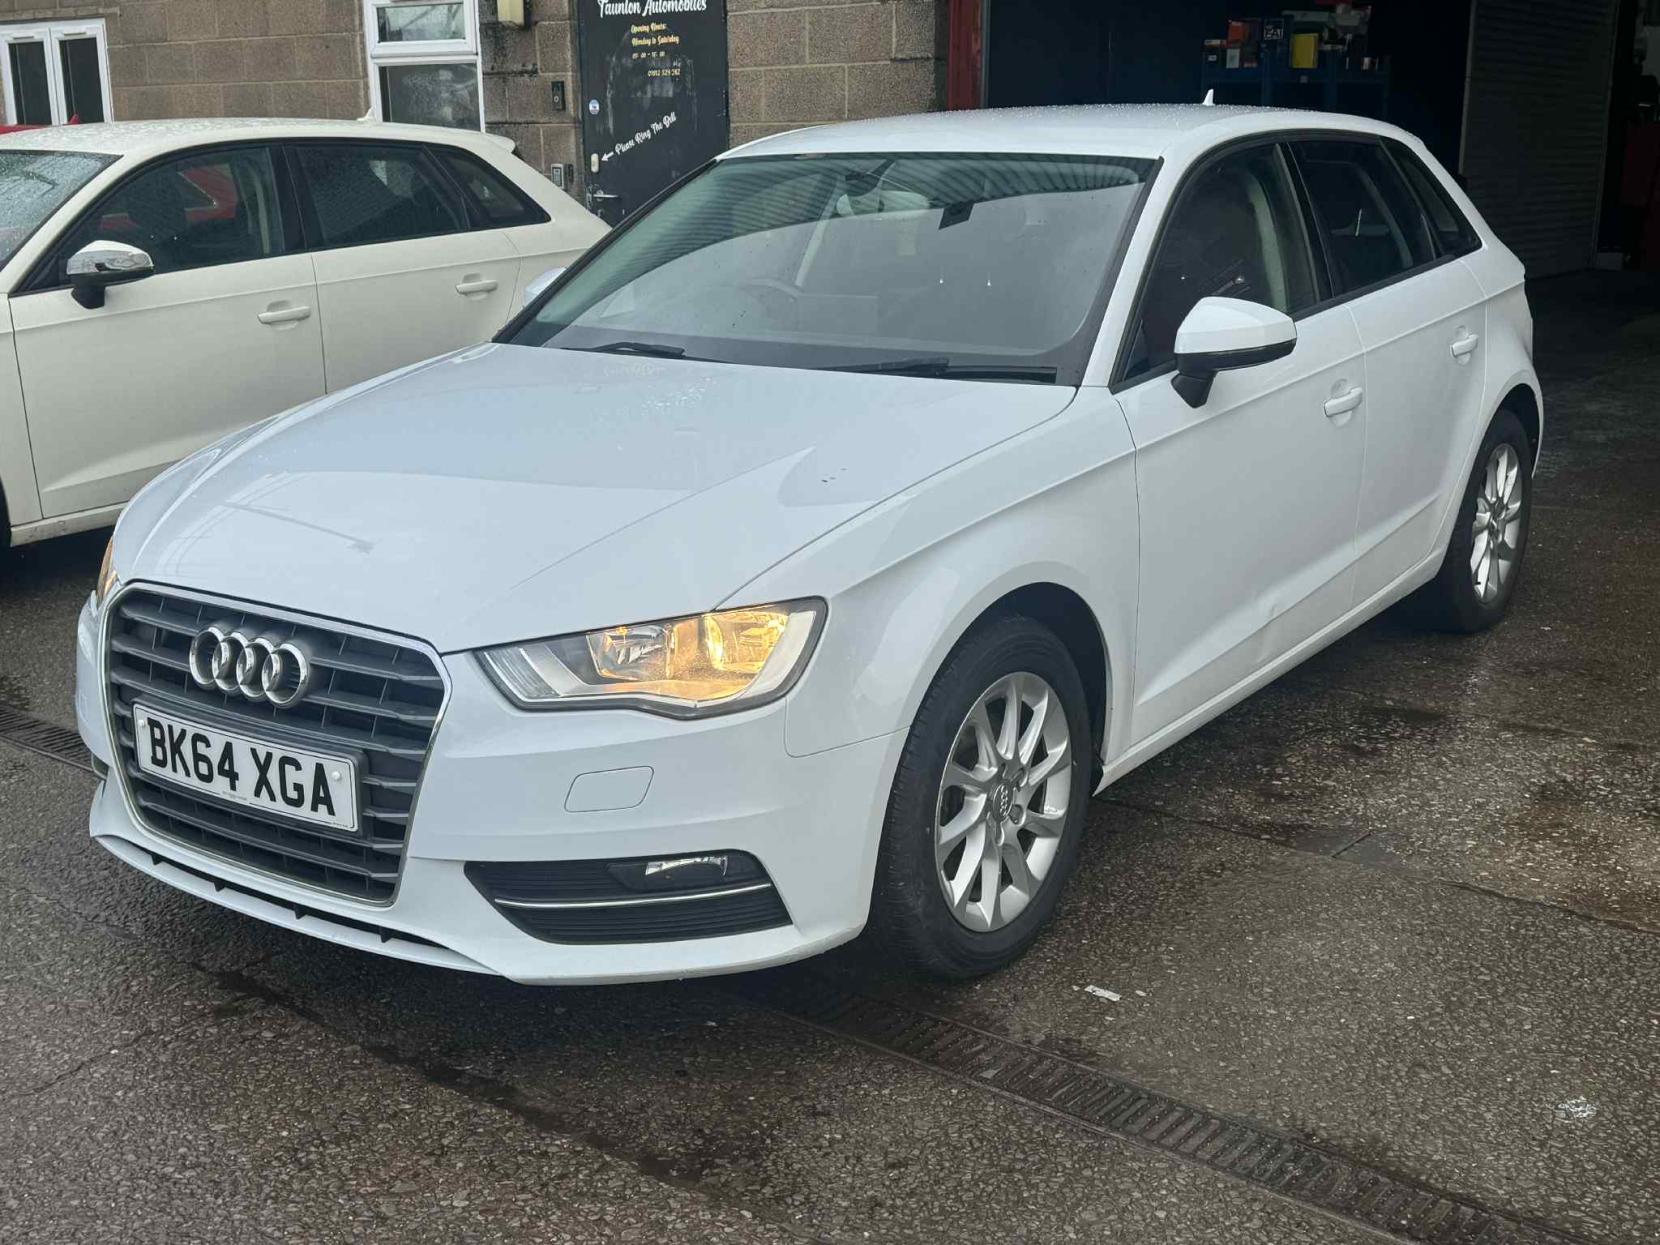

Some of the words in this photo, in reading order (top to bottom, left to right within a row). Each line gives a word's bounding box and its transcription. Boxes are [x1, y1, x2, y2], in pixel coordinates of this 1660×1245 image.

[615, 139, 635, 155] Please
[634, 129, 651, 145] Ring
[651, 121, 663, 135] The
[662, 111, 677, 129] Bell
[147, 717, 239, 791] BK64
[250, 747, 336, 816] XGA
